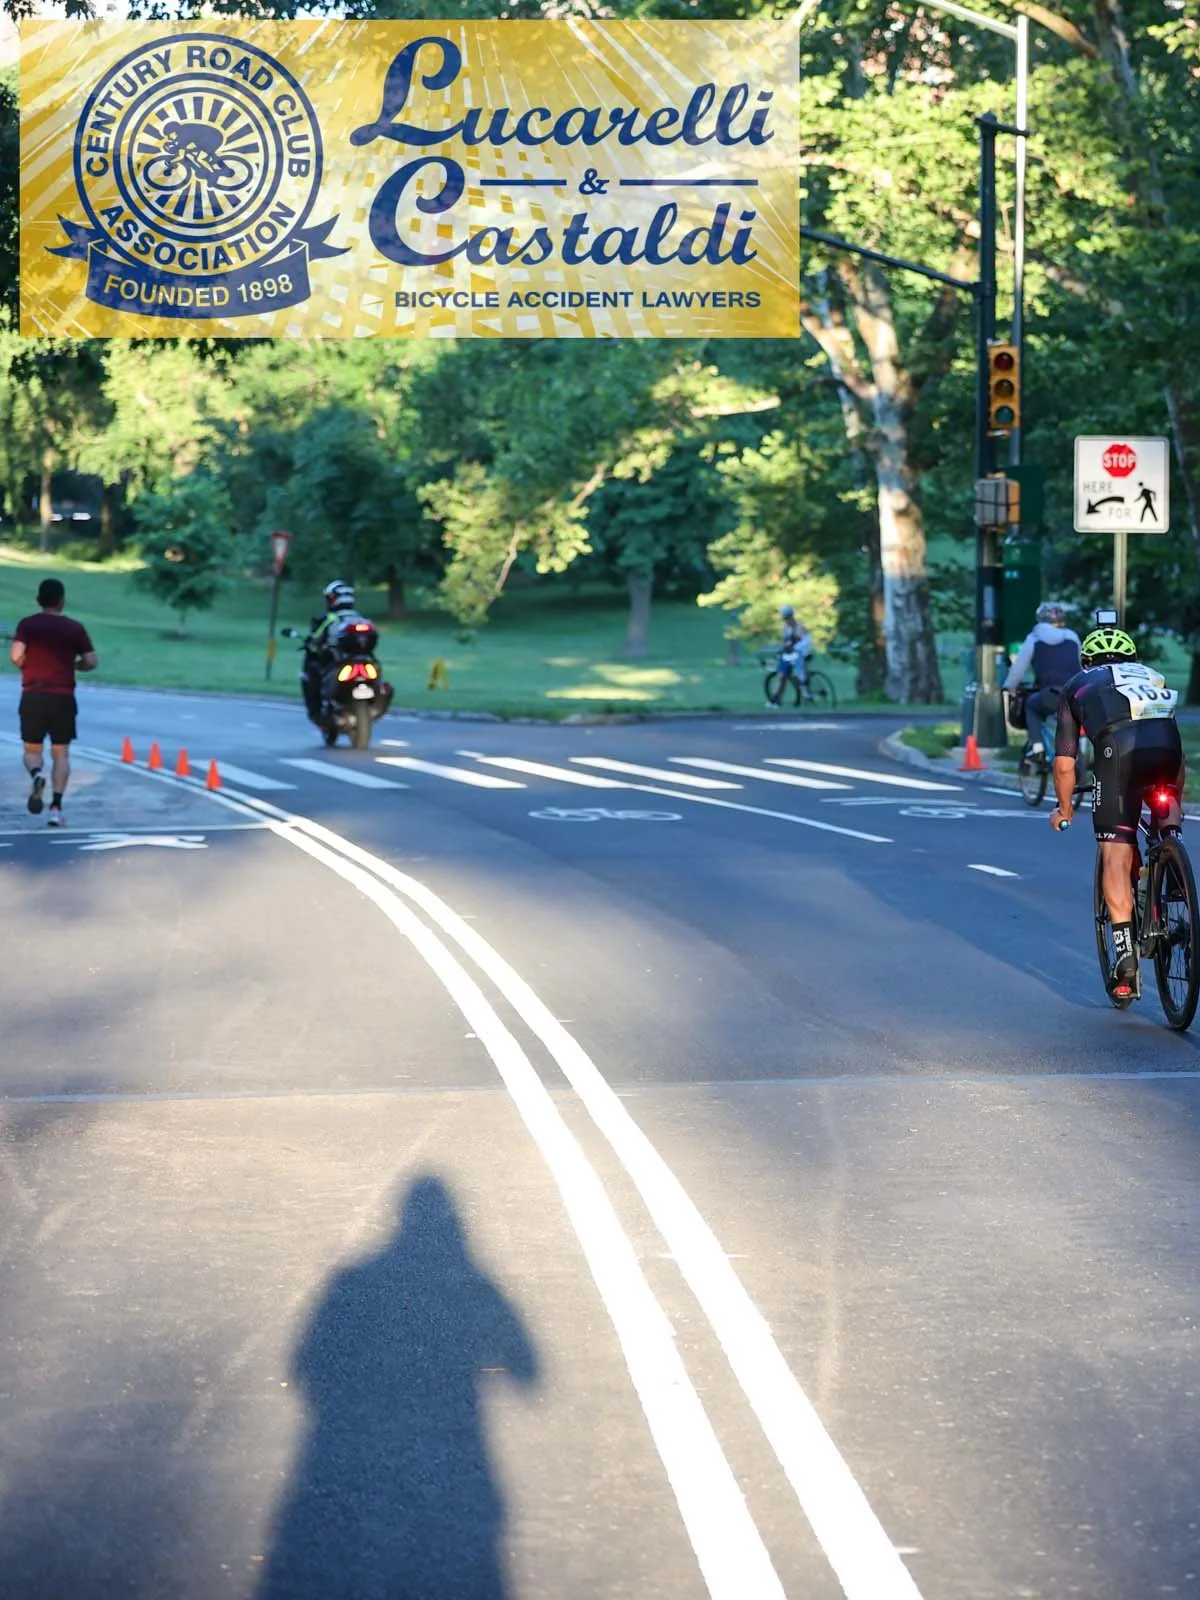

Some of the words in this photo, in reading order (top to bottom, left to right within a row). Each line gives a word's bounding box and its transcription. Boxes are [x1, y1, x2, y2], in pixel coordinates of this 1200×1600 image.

[1103, 452, 1137, 469] STOP
[1083, 481, 1113, 493] HERE
[1108, 506, 1132, 519] FOR
